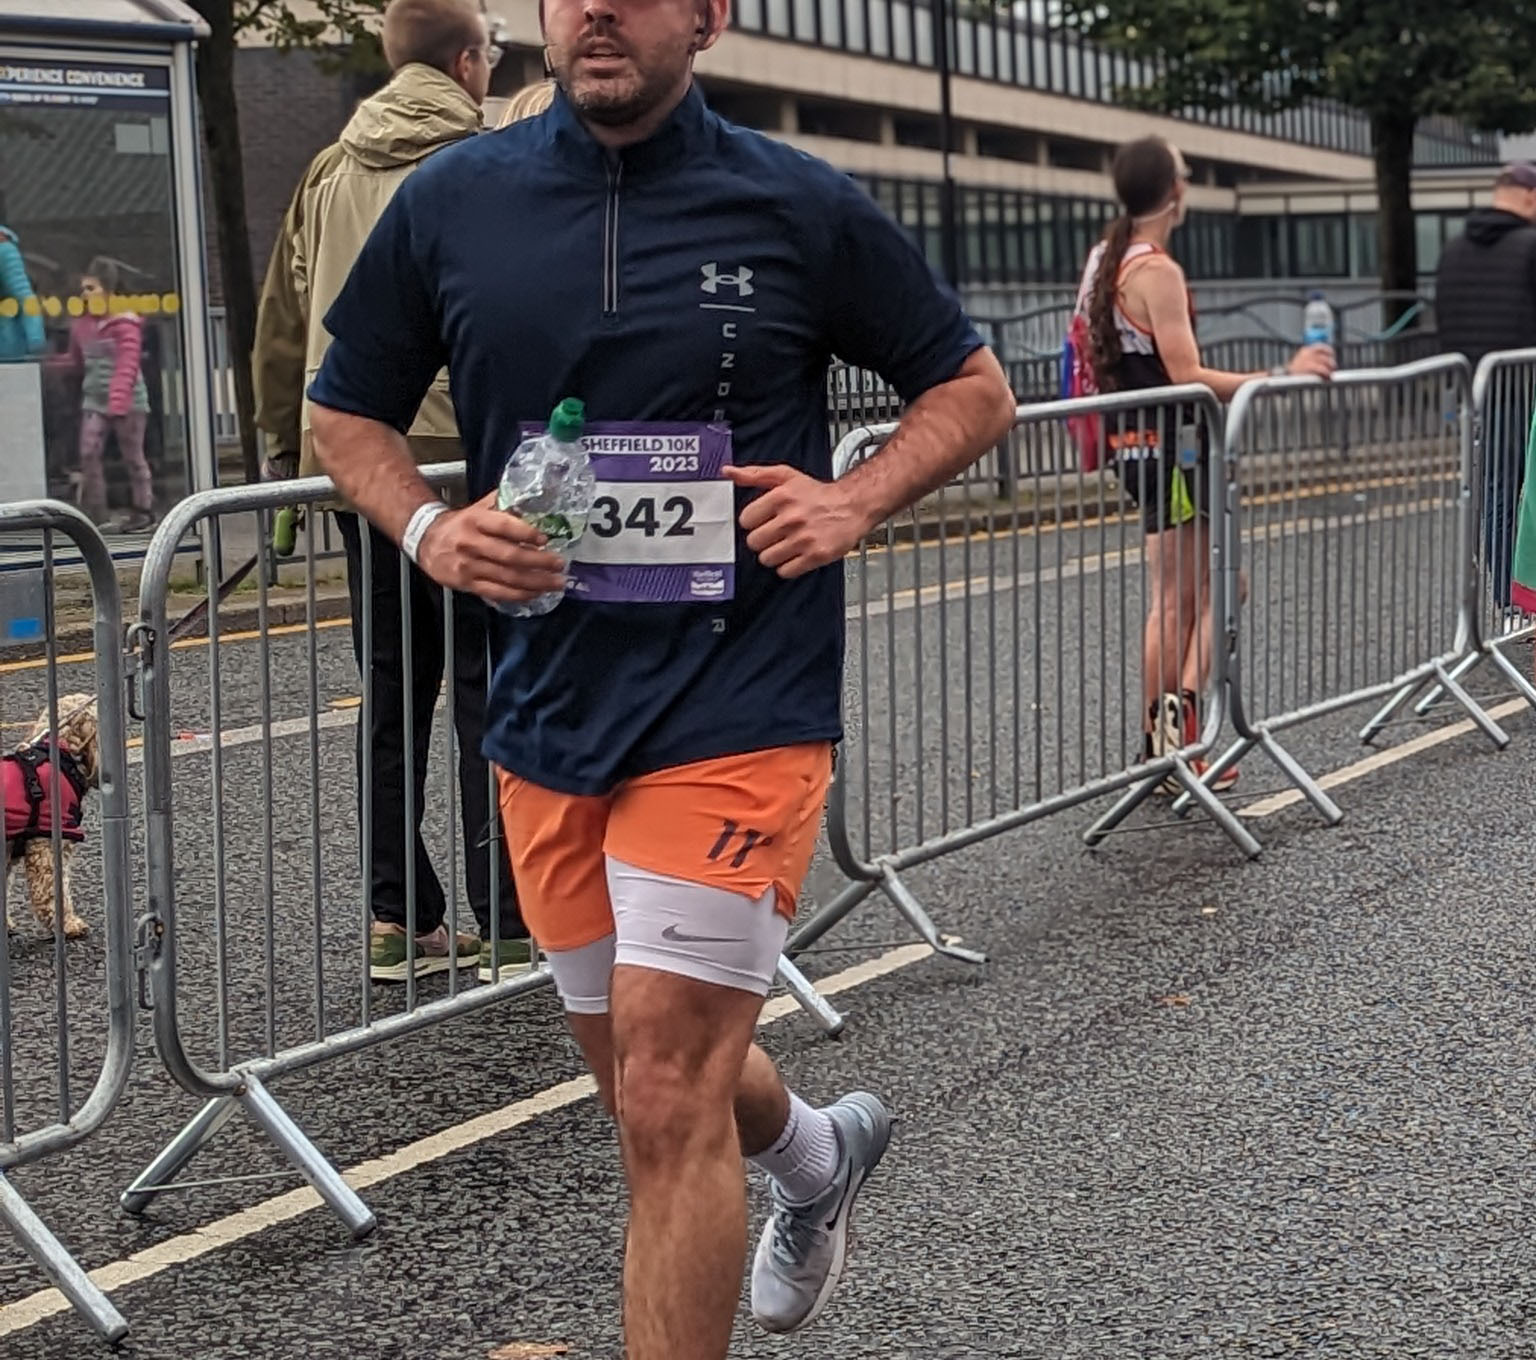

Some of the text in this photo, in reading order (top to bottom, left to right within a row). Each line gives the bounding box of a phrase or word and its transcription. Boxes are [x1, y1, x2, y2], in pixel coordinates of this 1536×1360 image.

[581, 438, 697, 452] SHEFFIELD 10K
[649, 456, 699, 473] 2023
[584, 495, 695, 538] 342
